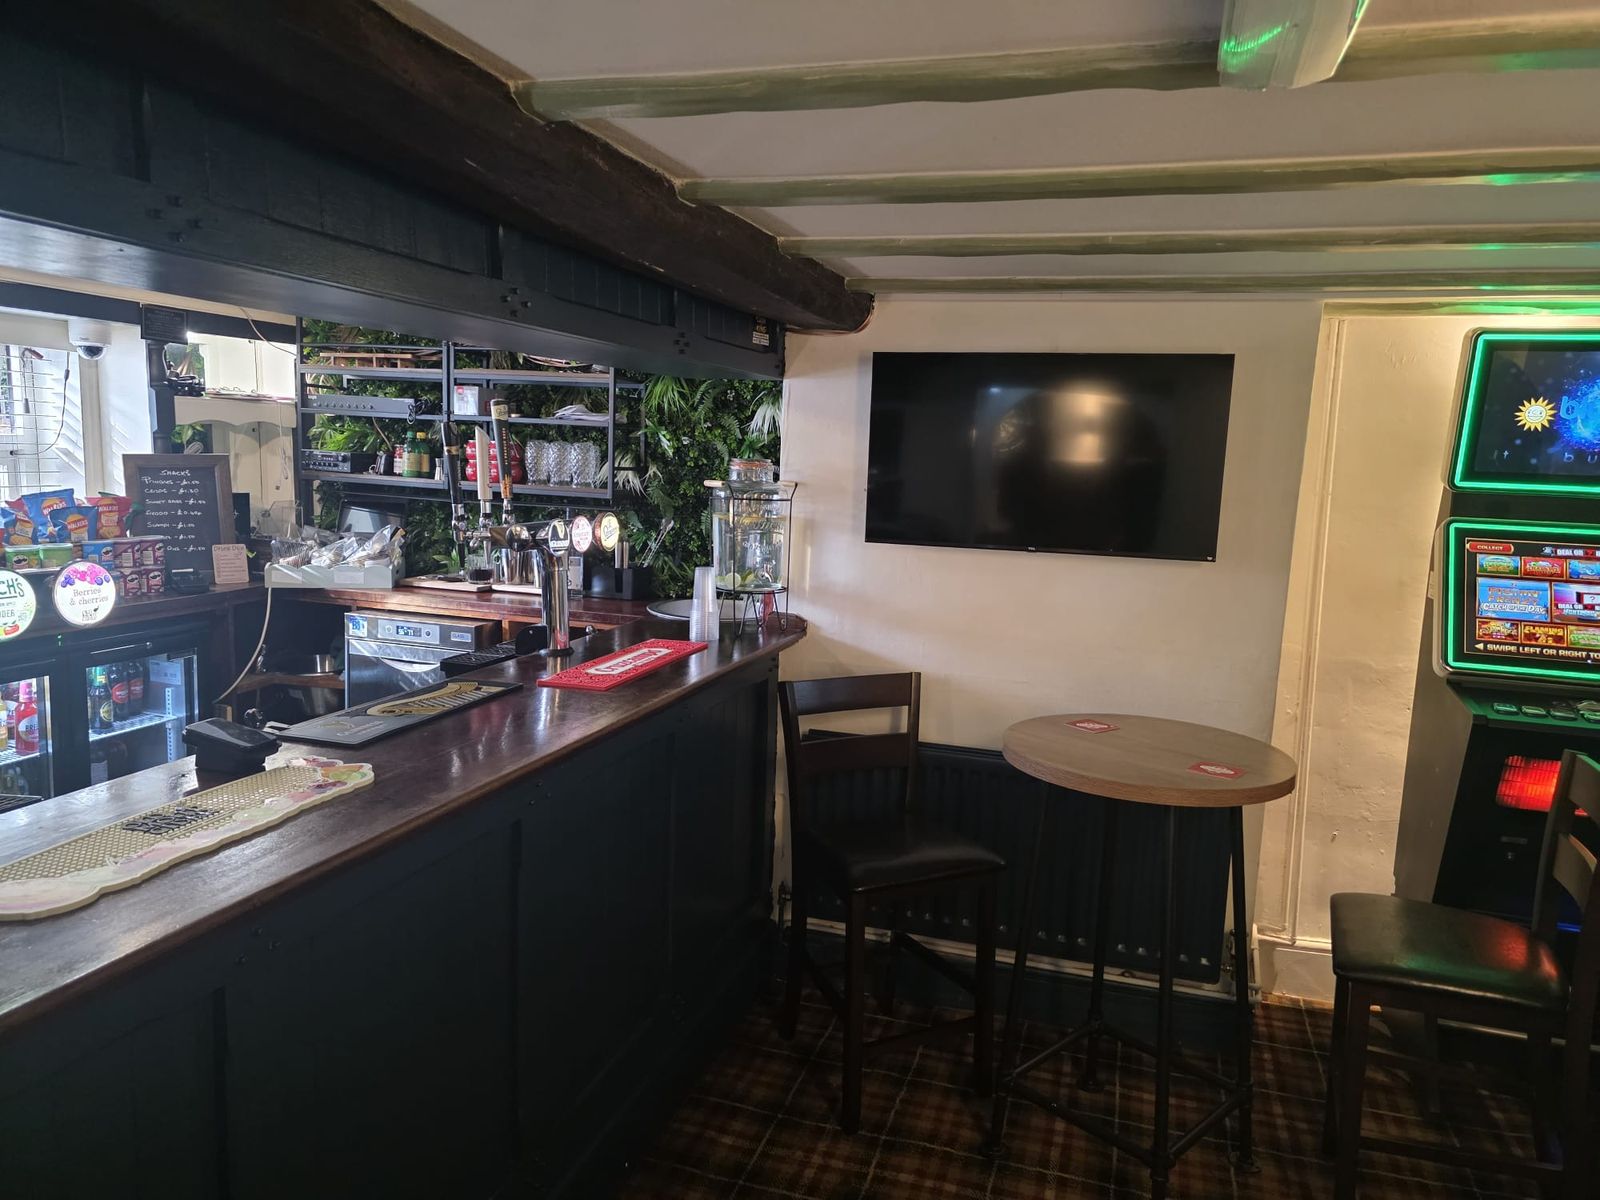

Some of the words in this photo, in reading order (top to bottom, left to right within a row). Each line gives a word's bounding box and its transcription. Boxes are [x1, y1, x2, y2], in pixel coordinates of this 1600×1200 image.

[0, 577, 25, 598] CH'S
[73, 587, 102, 597] Berries
[78, 595, 109, 605] cherries
[1487, 644, 1517, 652] SWIPE
[1519, 646, 1542, 655] LEFT
[1543, 648, 1557, 656] OR
[1558, 649, 1588, 658] RIGHT
